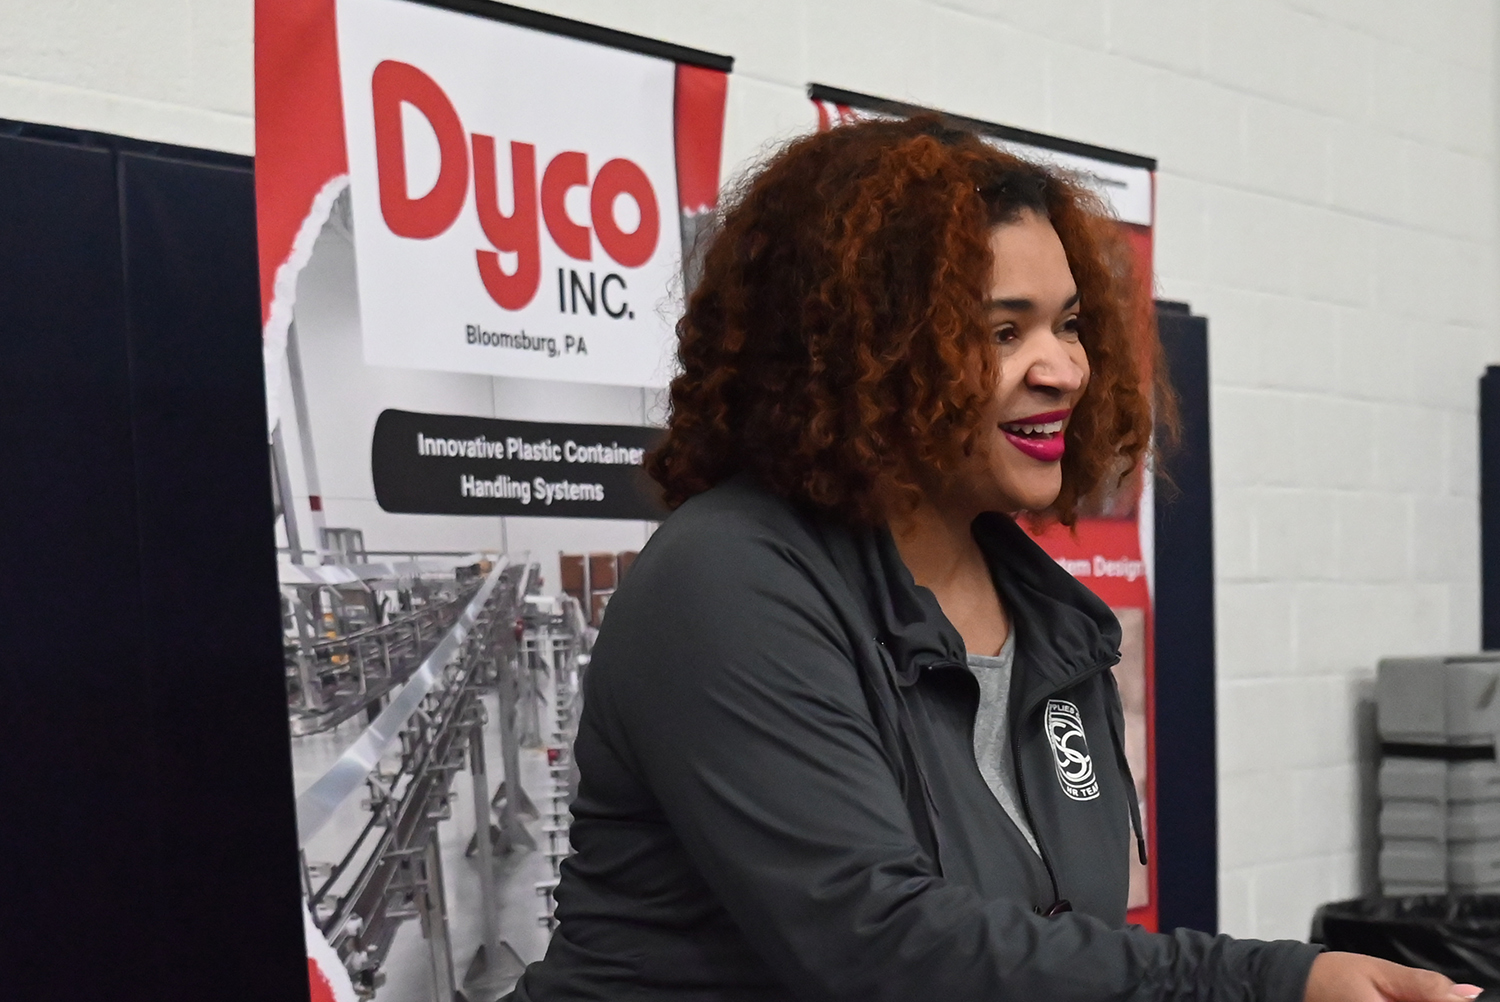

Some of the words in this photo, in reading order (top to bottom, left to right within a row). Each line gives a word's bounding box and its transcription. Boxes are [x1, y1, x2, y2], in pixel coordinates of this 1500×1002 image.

[371, 59, 660, 311] Dyco
[558, 268, 635, 319] INC.
[466, 324, 561, 357] Bloomsburg,
[565, 334, 588, 355] PA
[417, 432, 504, 460] Innovative
[506, 437, 562, 462] Plastic
[564, 440, 645, 466] Container
[460, 474, 531, 505] Handling
[533, 477, 604, 505] Systems
